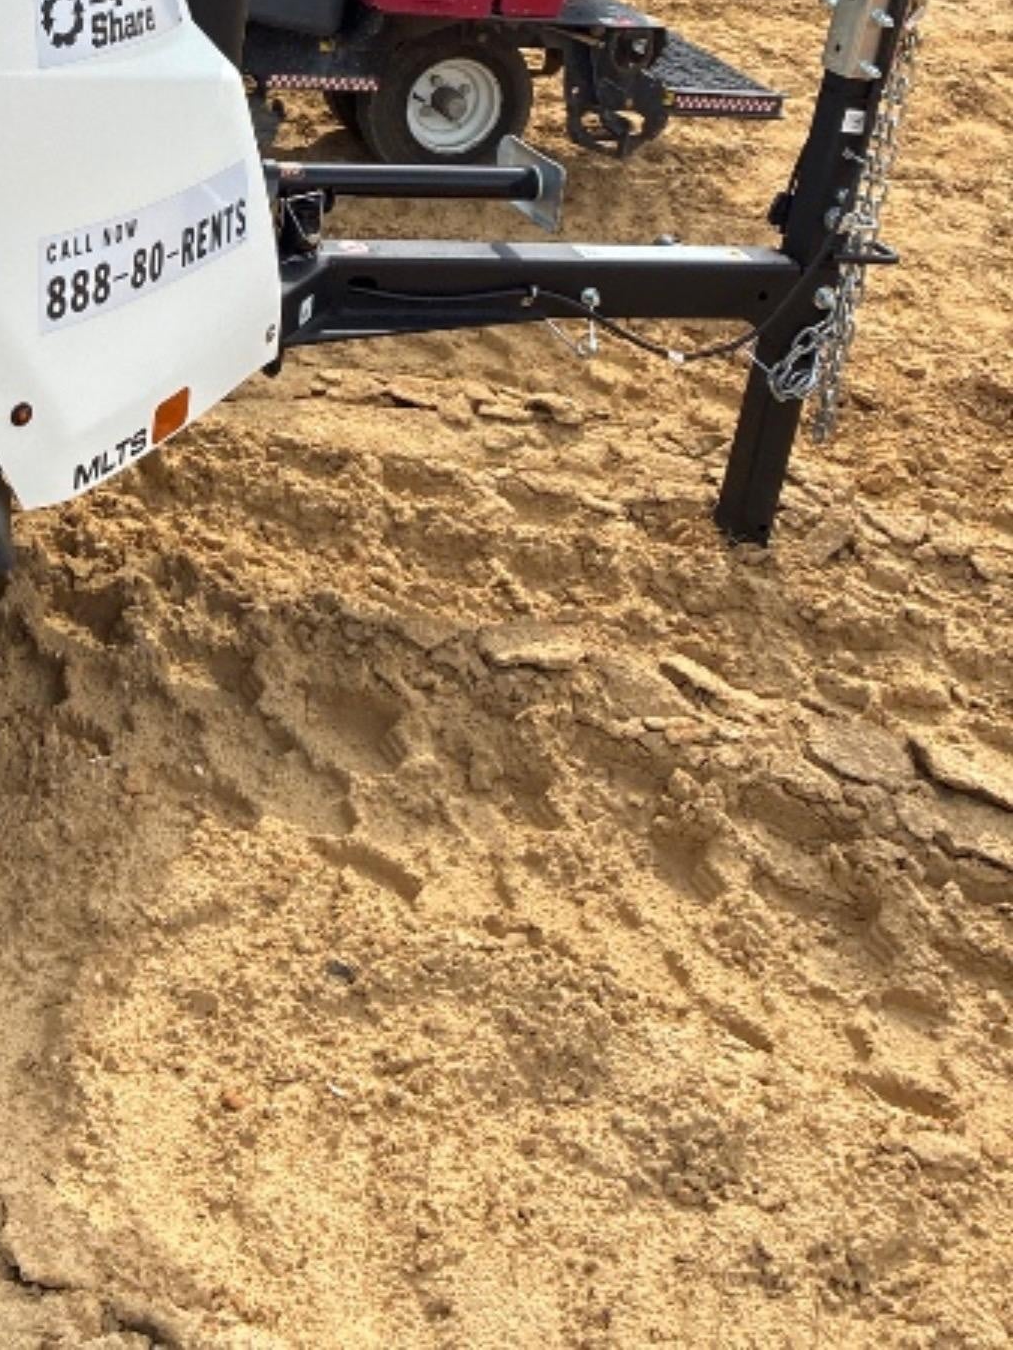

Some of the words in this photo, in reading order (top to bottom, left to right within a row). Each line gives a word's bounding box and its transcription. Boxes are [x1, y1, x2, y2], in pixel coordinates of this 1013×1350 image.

[91, 5, 156, 48] Share
[46, 233, 93, 264] CALL
[103, 218, 138, 247] NOW
[46, 198, 247, 321] 888-80-RENTS
[73, 428, 147, 490] MLTS
